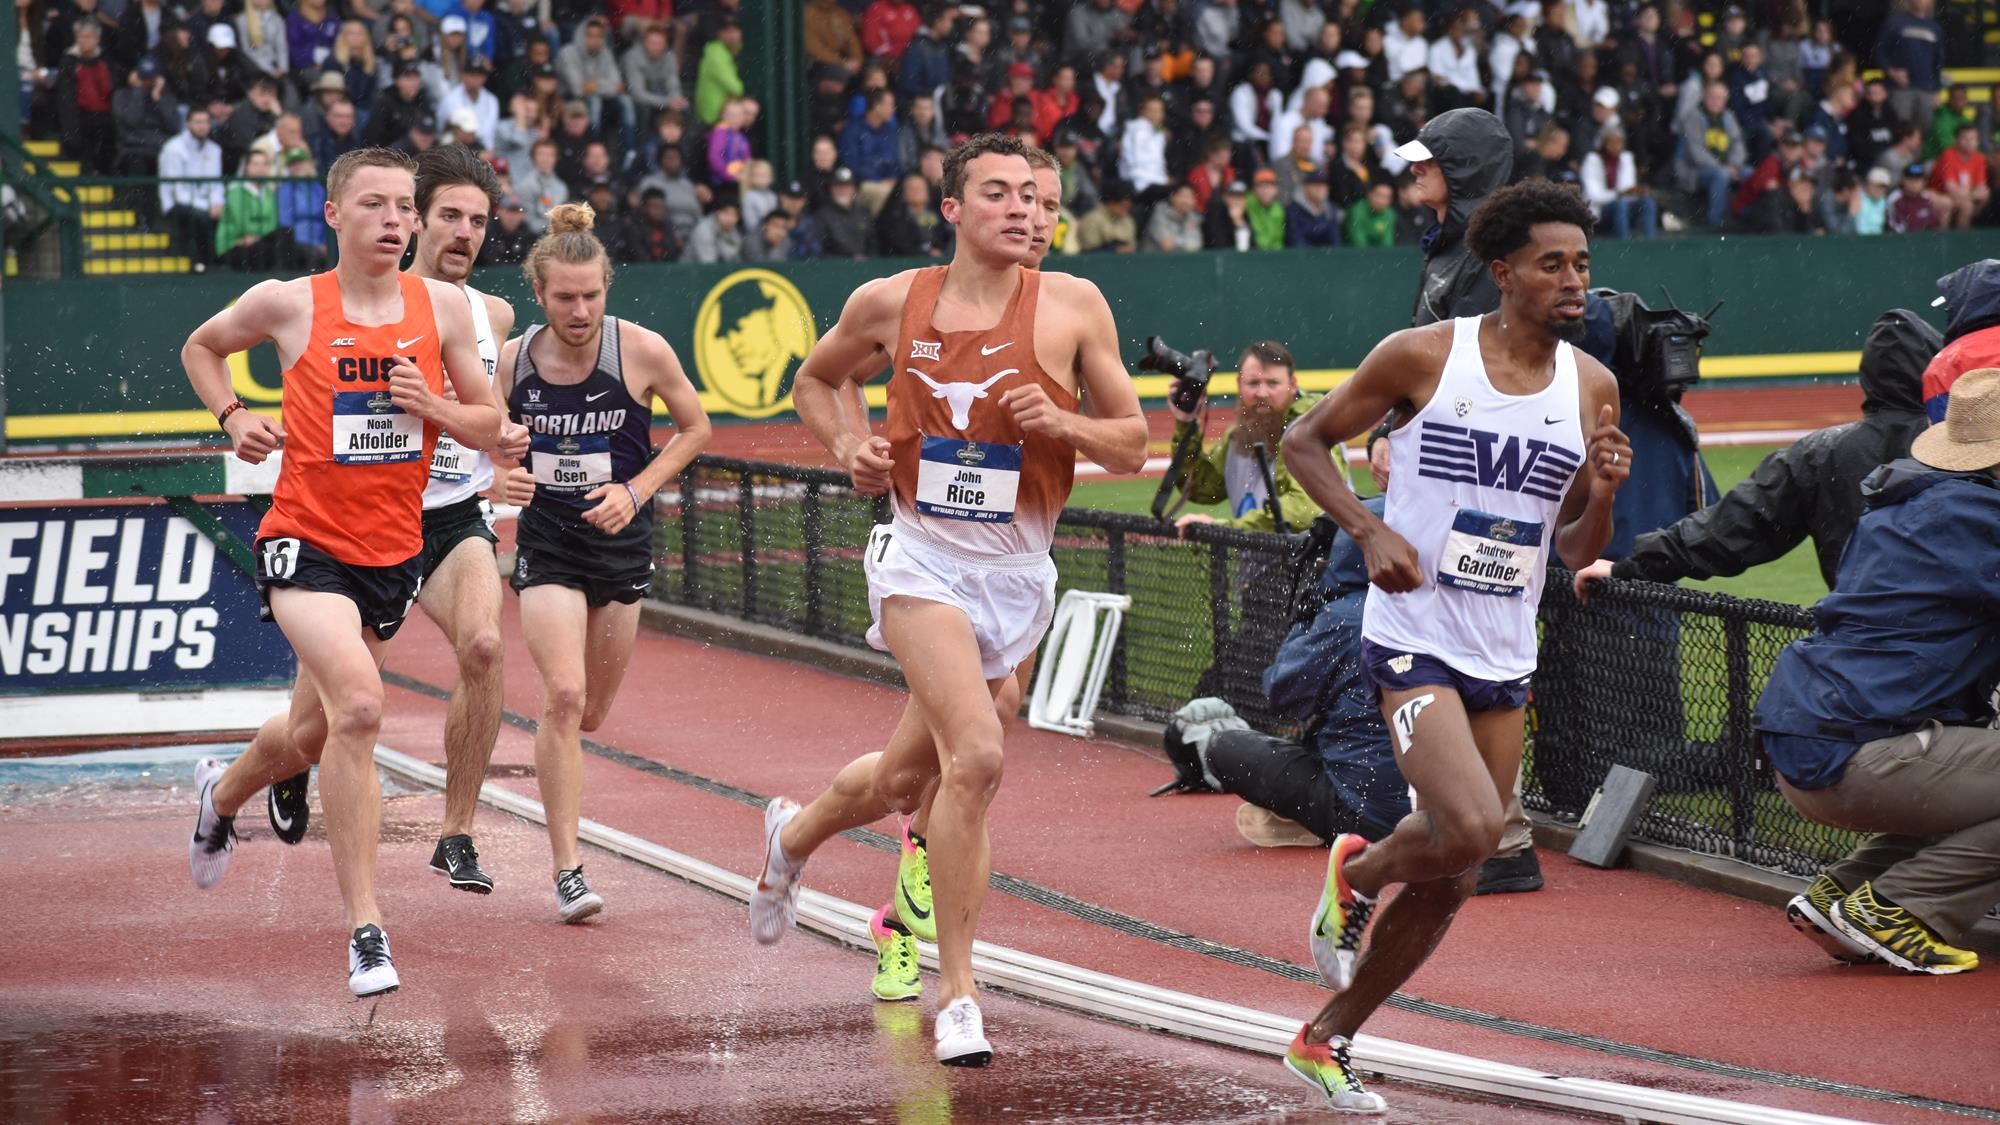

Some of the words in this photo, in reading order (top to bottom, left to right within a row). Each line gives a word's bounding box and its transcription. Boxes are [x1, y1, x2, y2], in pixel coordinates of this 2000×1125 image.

[330, 337, 356, 347] ACC
[911, 340, 942, 361] XII
[331, 356, 417, 382] 'CUS
[367, 419, 392, 430] Noah
[521, 409, 626, 435] PORTLAND
[348, 432, 408, 450] Affolder
[430, 453, 460, 470] enoit
[559, 458, 581, 468] Riley
[1469, 429, 1548, 493] W
[554, 469, 588, 483] Osen
[954, 470, 982, 484] John
[946, 484, 985, 505] Rice
[955, 509, 969, 517] FIELD
[975, 511, 989, 519] JUNE
[270, 541, 290, 579] 6
[1475, 542, 1515, 560] Andrew
[0, 517, 215, 607] FIELD
[1457, 554, 1520, 582] Gardner
[0, 607, 219, 676] NSHIPS
[1387, 654, 1413, 674] W
